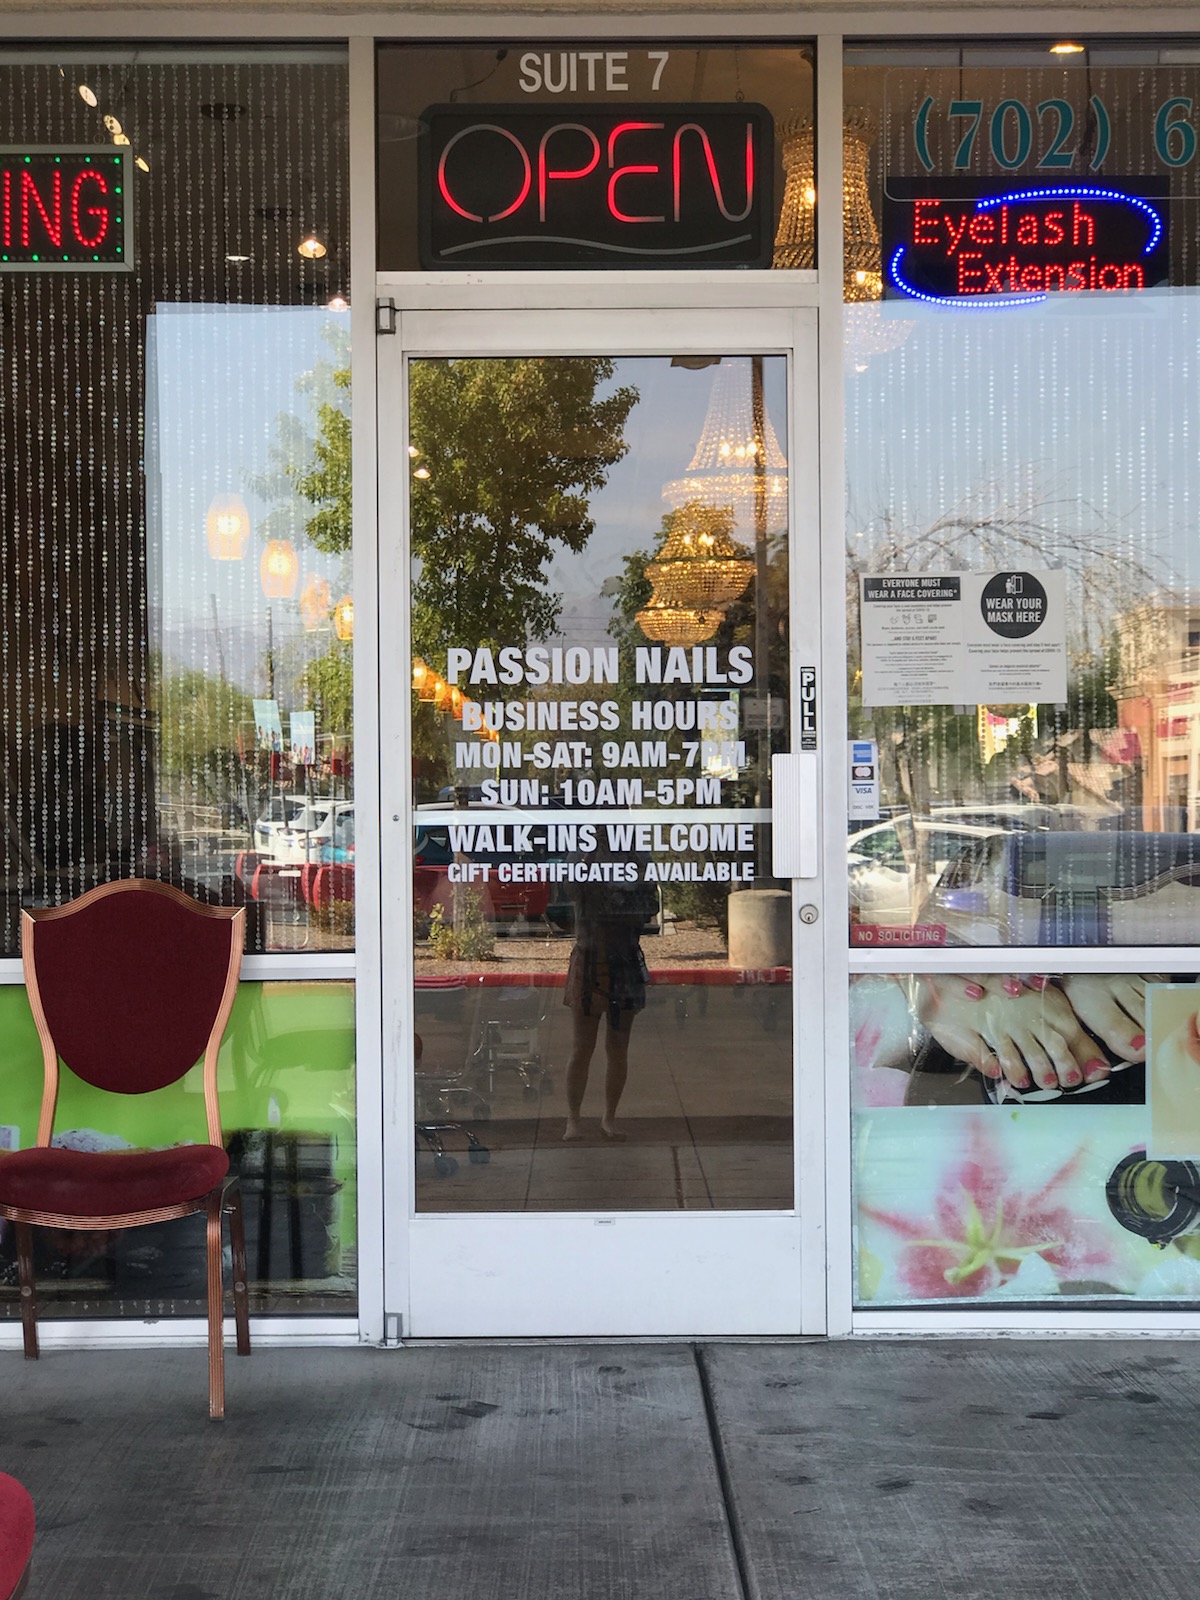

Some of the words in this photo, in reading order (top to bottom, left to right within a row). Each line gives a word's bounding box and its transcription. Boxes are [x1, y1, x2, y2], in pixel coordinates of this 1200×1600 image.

[518, 52, 629, 93] SUITE
[648, 51, 670, 91] 7
[914, 96, 1111, 172] (702)
[437, 121, 755, 224] OPEN
[913, 199, 1096, 256] Eyelash
[957, 252, 1145, 293] Extension
[868, 590, 889, 599] WEAR
[890, 590, 896, 598] A
[897, 589, 916, 598] FACE
[882, 578, 920, 588] EVERYONE
[921, 578, 941, 587] MUST
[986, 598, 1014, 609] WEAR
[1016, 598, 1042, 609] YOUR
[987, 611, 1014, 623] MASK
[1016, 611, 1041, 623] HERE
[447, 647, 619, 685] PASSION
[635, 646, 754, 684] NAILS
[801, 672, 815, 731] PULL
[462, 701, 620, 731] BUSINESS
[632, 701, 739, 731] HOURS
[455, 742, 592, 769] MON-SAT:
[602, 741, 746, 768] 9AM-7PM
[480, 779, 549, 806] SUN:
[560, 779, 722, 806] 10AM-5PM
[448, 825, 597, 852] WALK-INS
[607, 824, 755, 852] WELCOME
[447, 863, 492, 882] GIFT
[498, 863, 639, 882] CERTIFICATES
[644, 862, 755, 881] AVAILABLE
[858, 930, 873, 941] NO
[878, 930, 940, 941] SOLICITING
